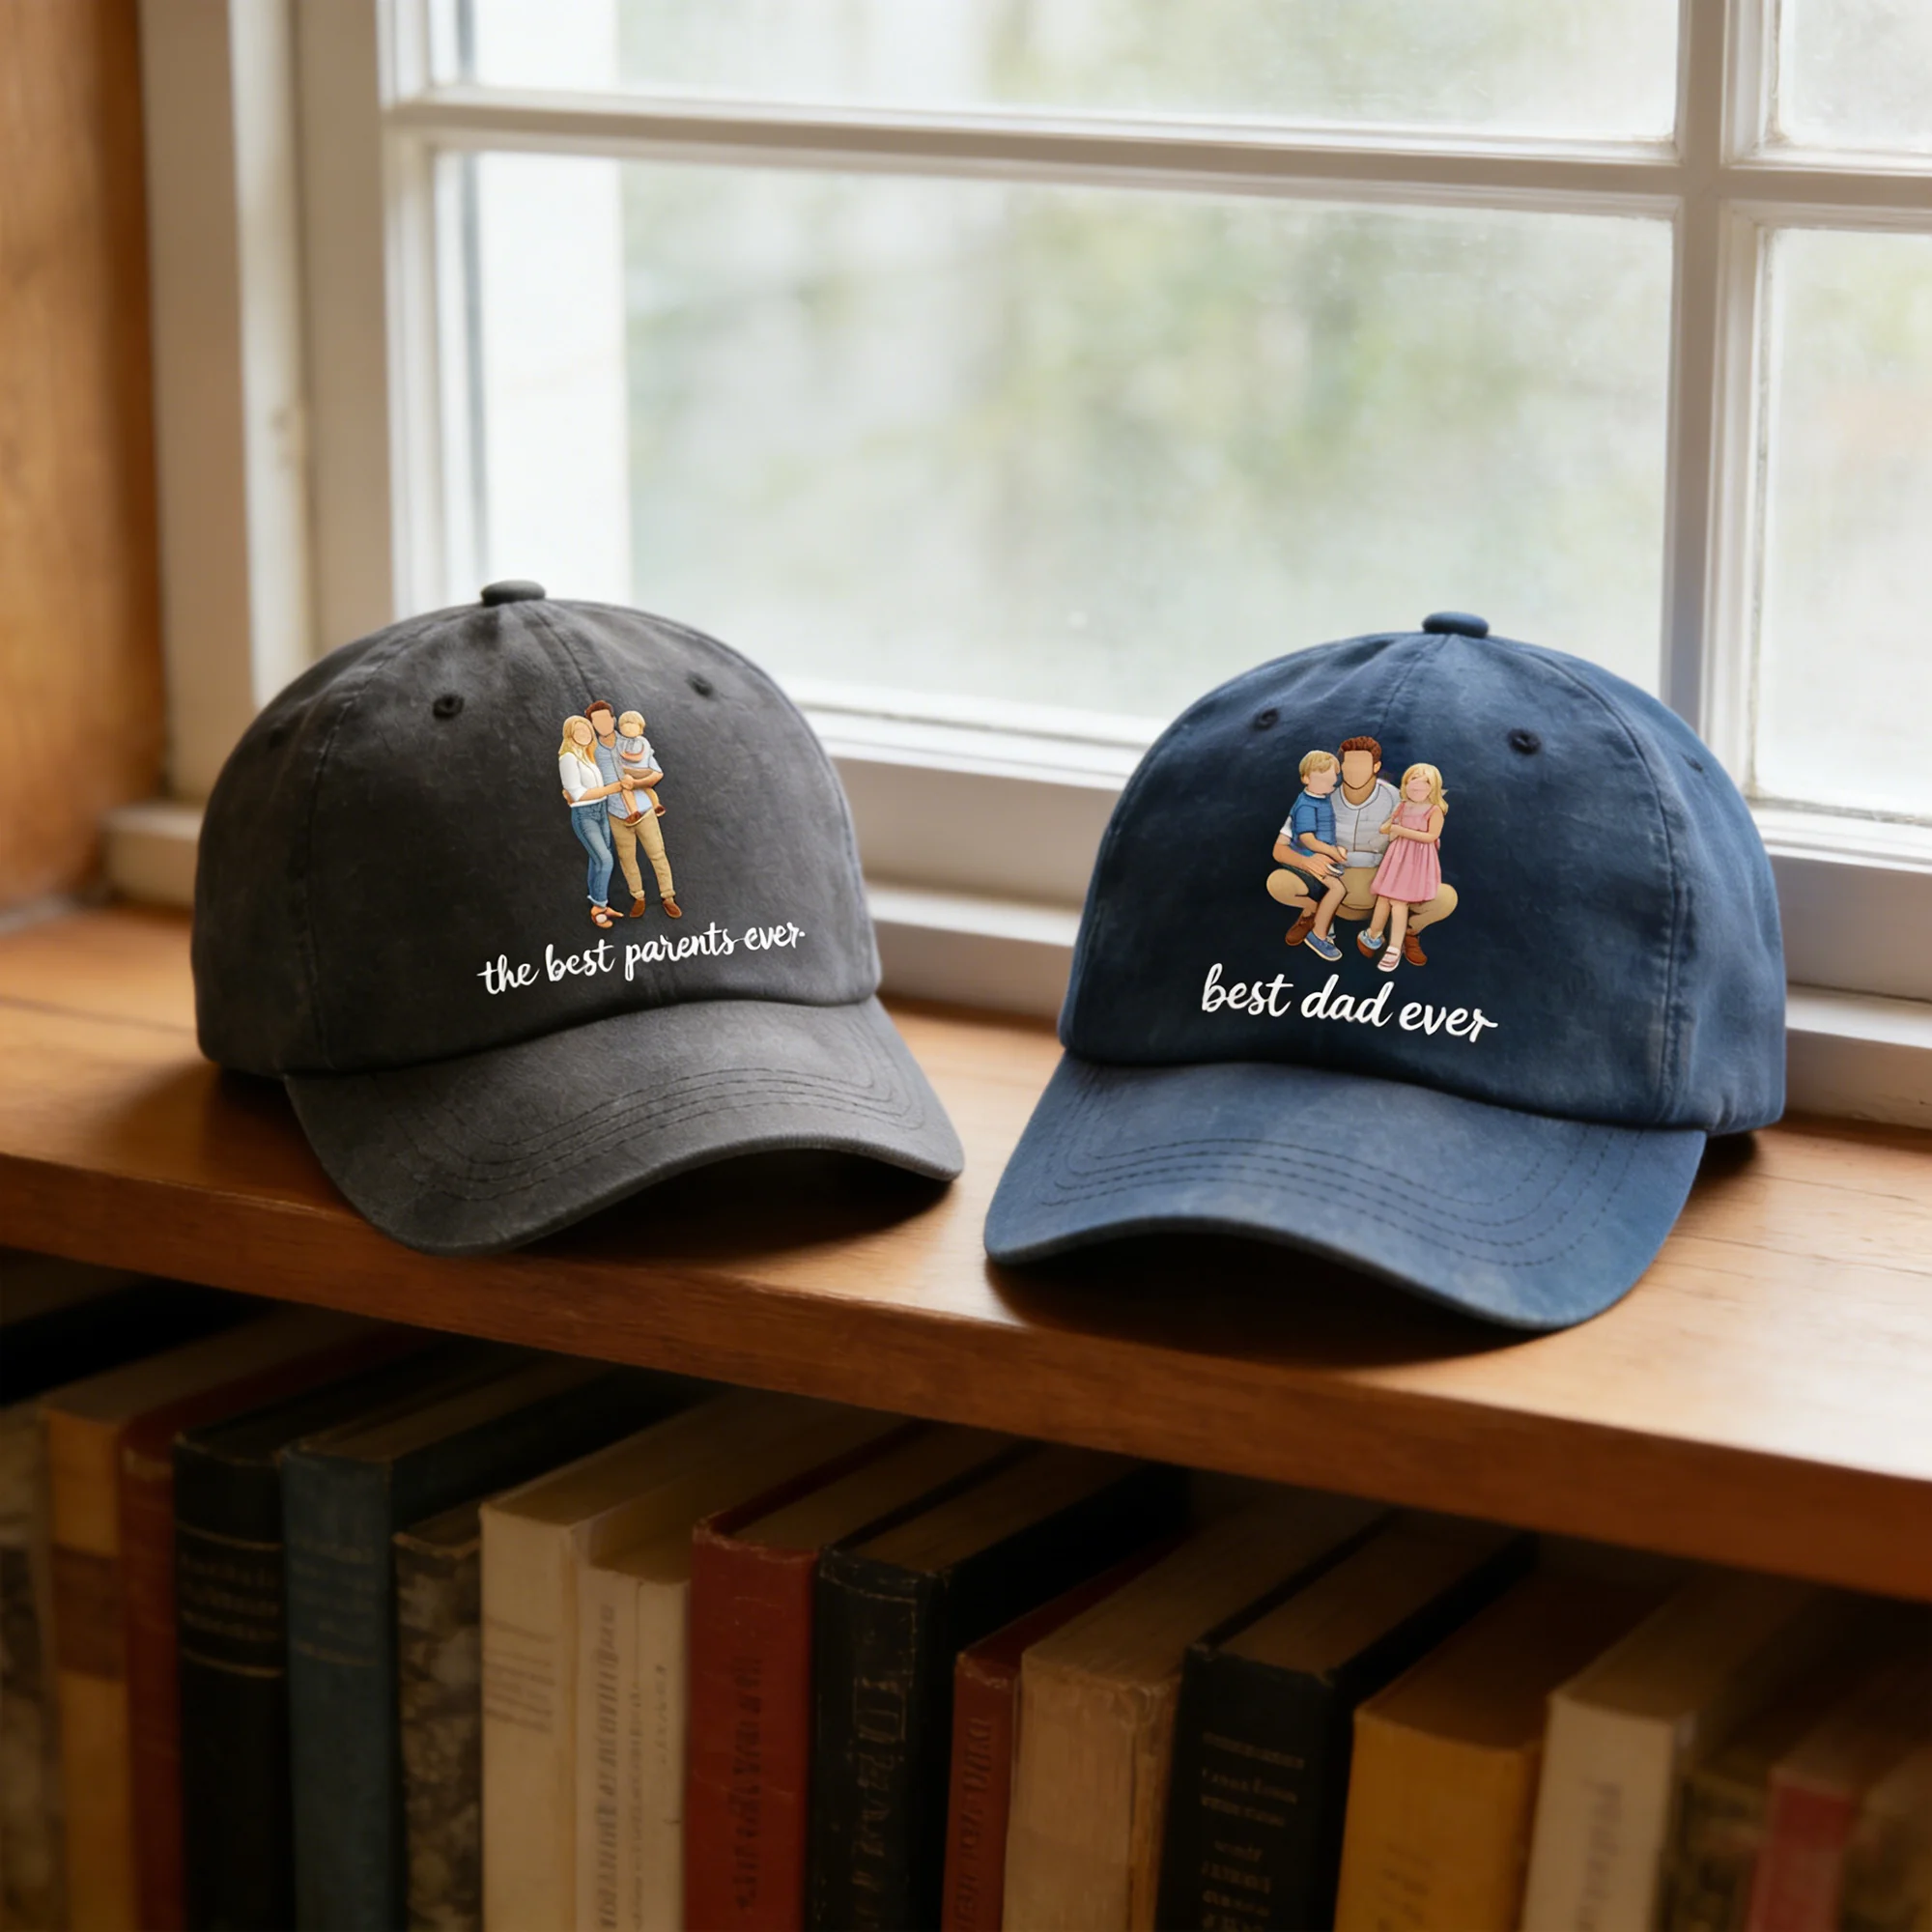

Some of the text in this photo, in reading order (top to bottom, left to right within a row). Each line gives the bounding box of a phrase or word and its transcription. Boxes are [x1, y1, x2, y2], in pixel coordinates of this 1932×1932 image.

[476, 921, 806, 995] the best parents ever
[1201, 962, 1499, 1043] best dad ever
